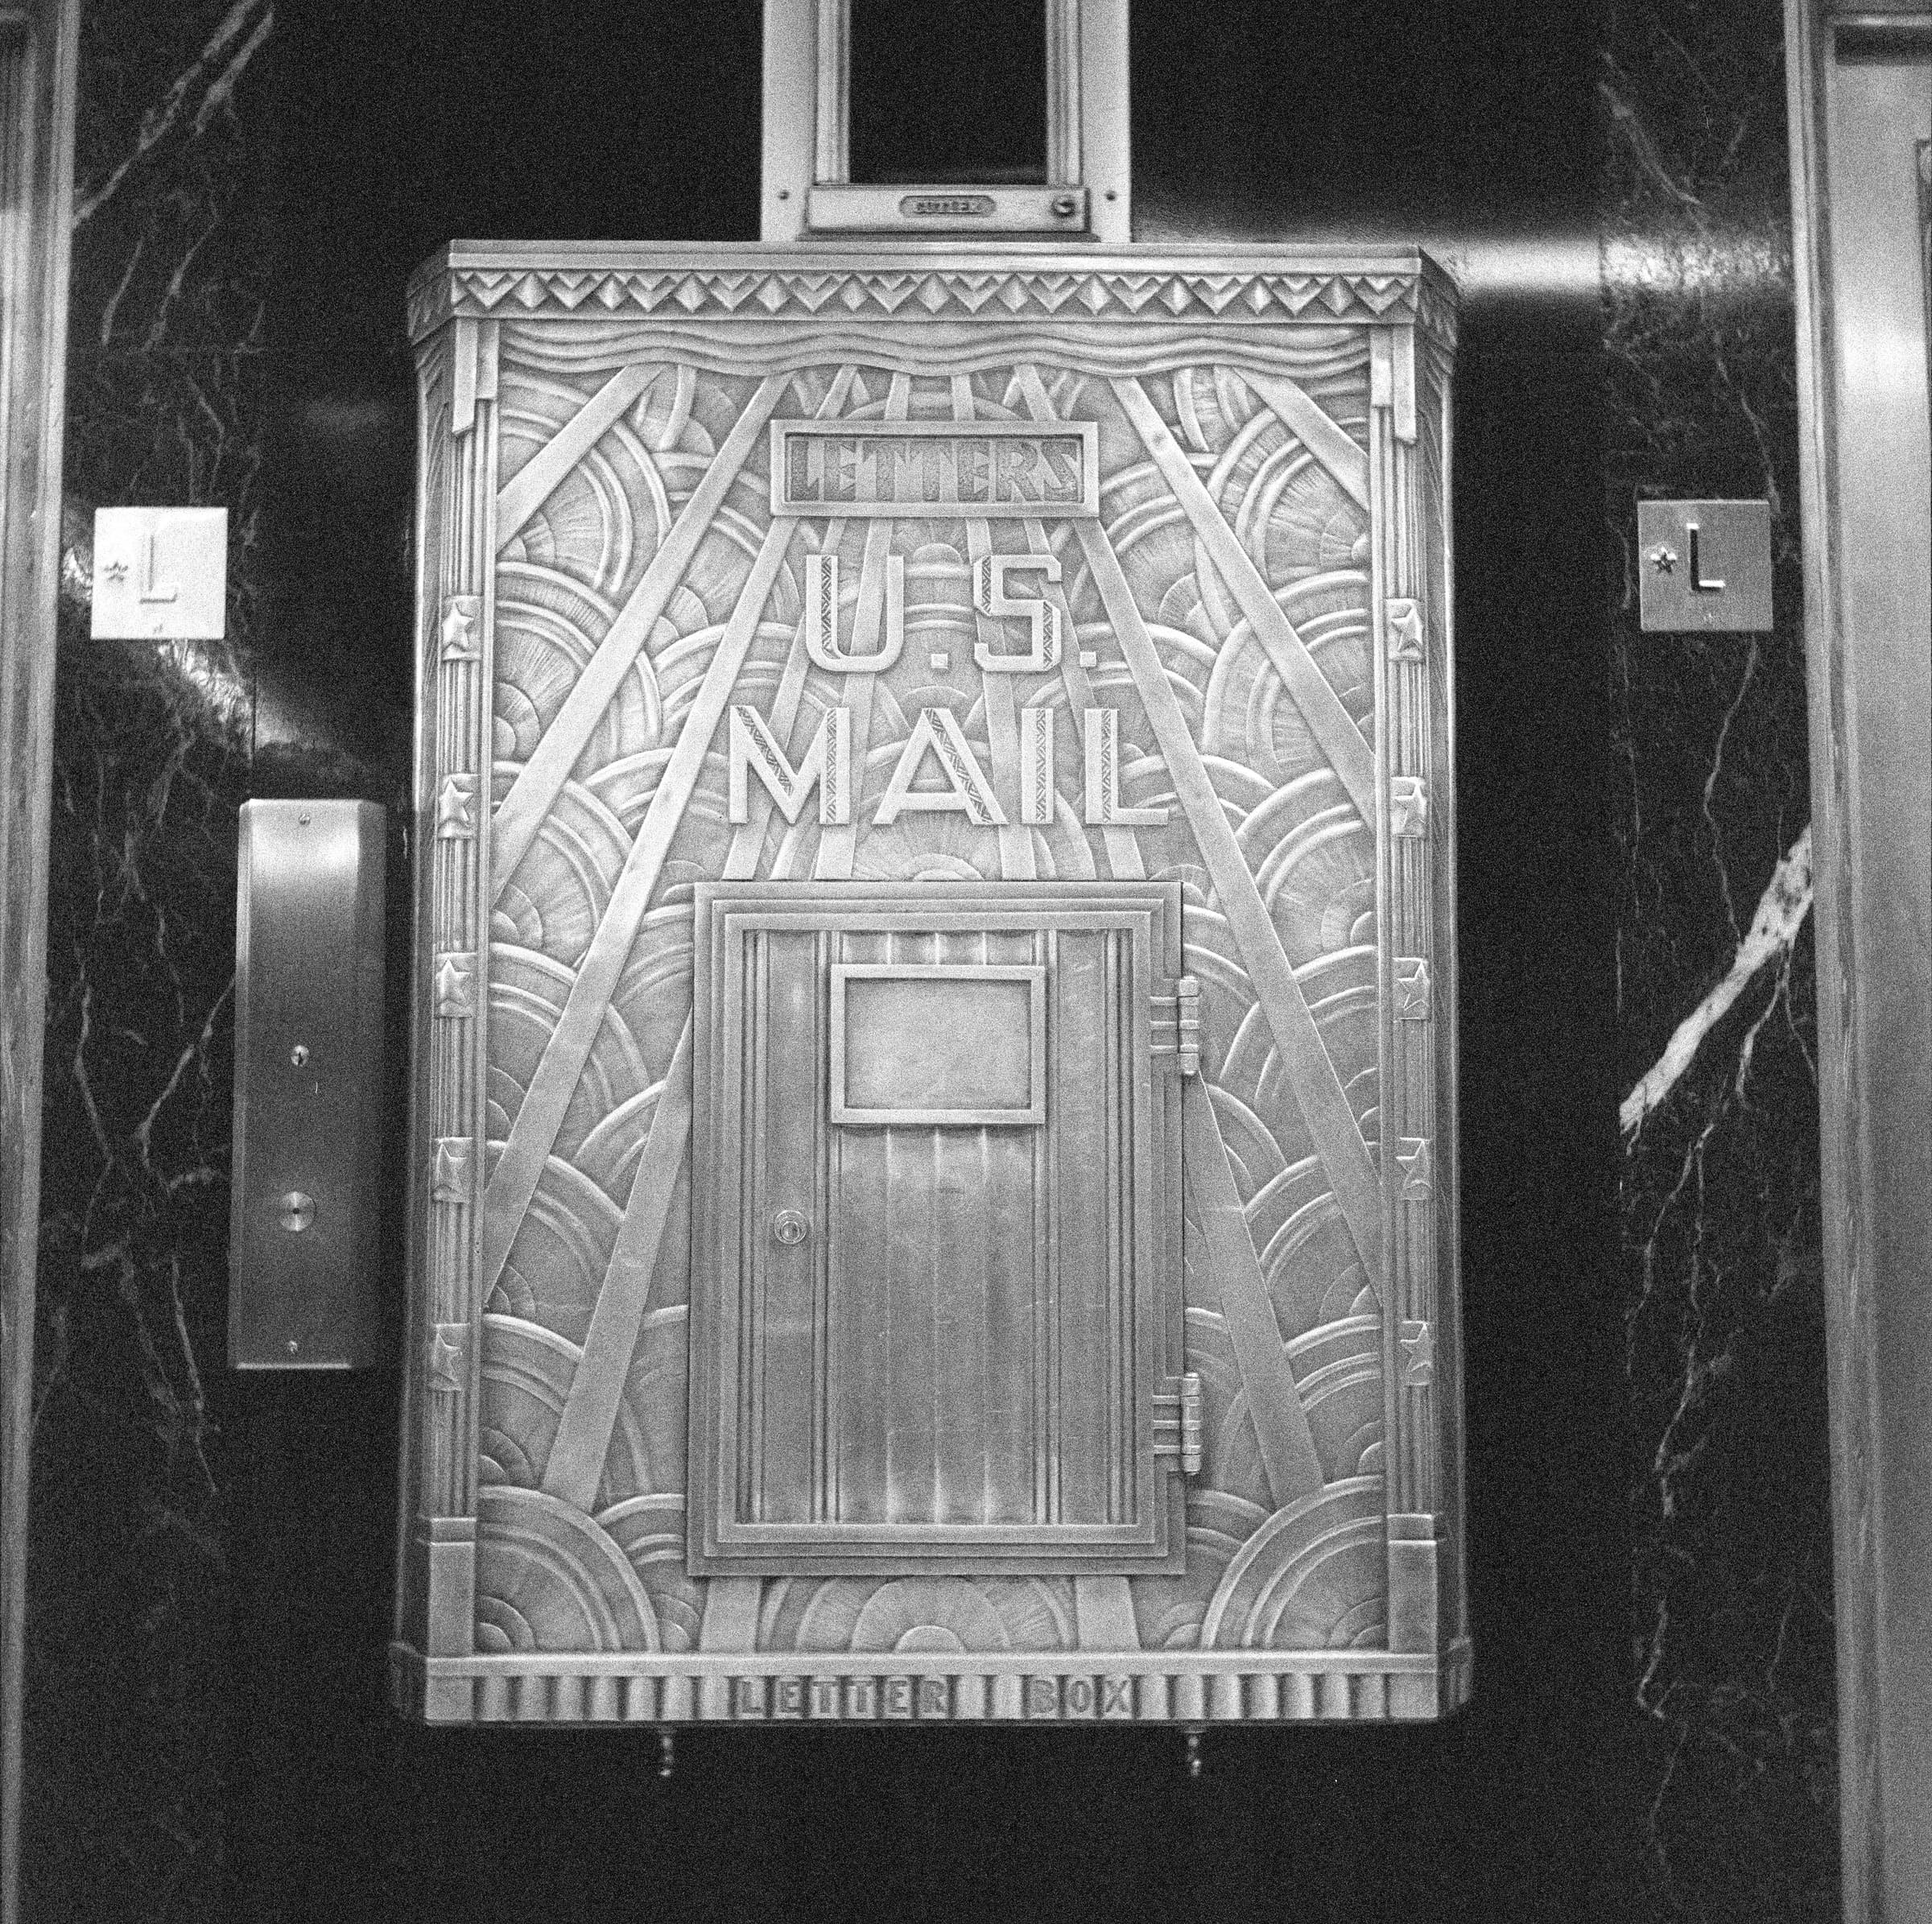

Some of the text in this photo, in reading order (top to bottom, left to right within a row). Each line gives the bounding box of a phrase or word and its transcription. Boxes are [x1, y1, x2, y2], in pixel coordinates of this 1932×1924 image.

[788, 439, 1080, 502] LETTERS
[139, 535, 177, 603] L
[1687, 523, 1725, 592] L
[805, 554, 1096, 672] U.S.
[729, 705, 1169, 824] MAIL
[741, 1680, 1129, 1714] LETTER BOX
